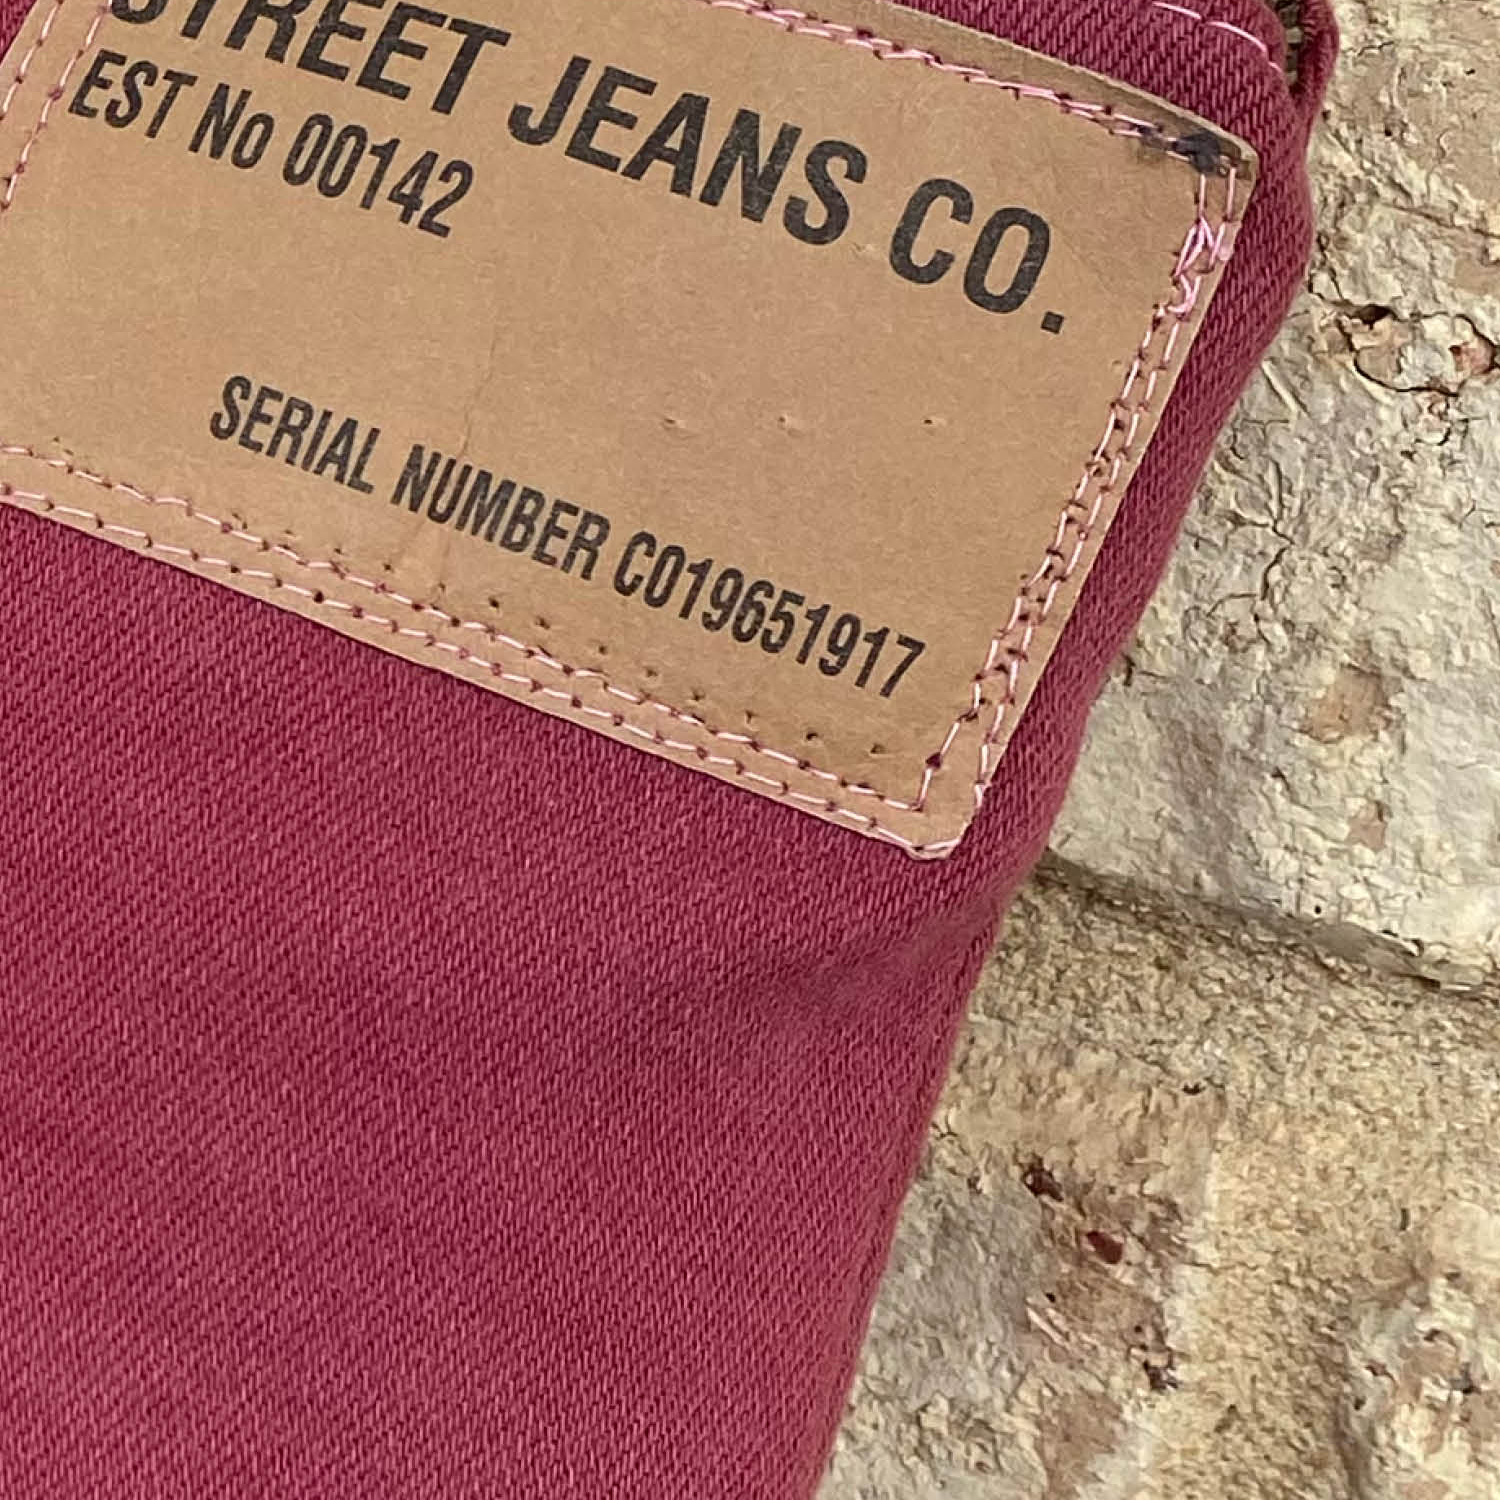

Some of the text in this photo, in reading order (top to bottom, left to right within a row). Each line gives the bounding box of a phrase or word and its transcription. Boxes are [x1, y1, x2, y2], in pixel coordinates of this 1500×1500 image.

[68, 51, 473, 238] EST No 00142
[508, 56, 867, 245] JEANS
[890, 179, 1064, 334] CO.
[210, 376, 925, 698] SERIAL NUMBER C019651917
